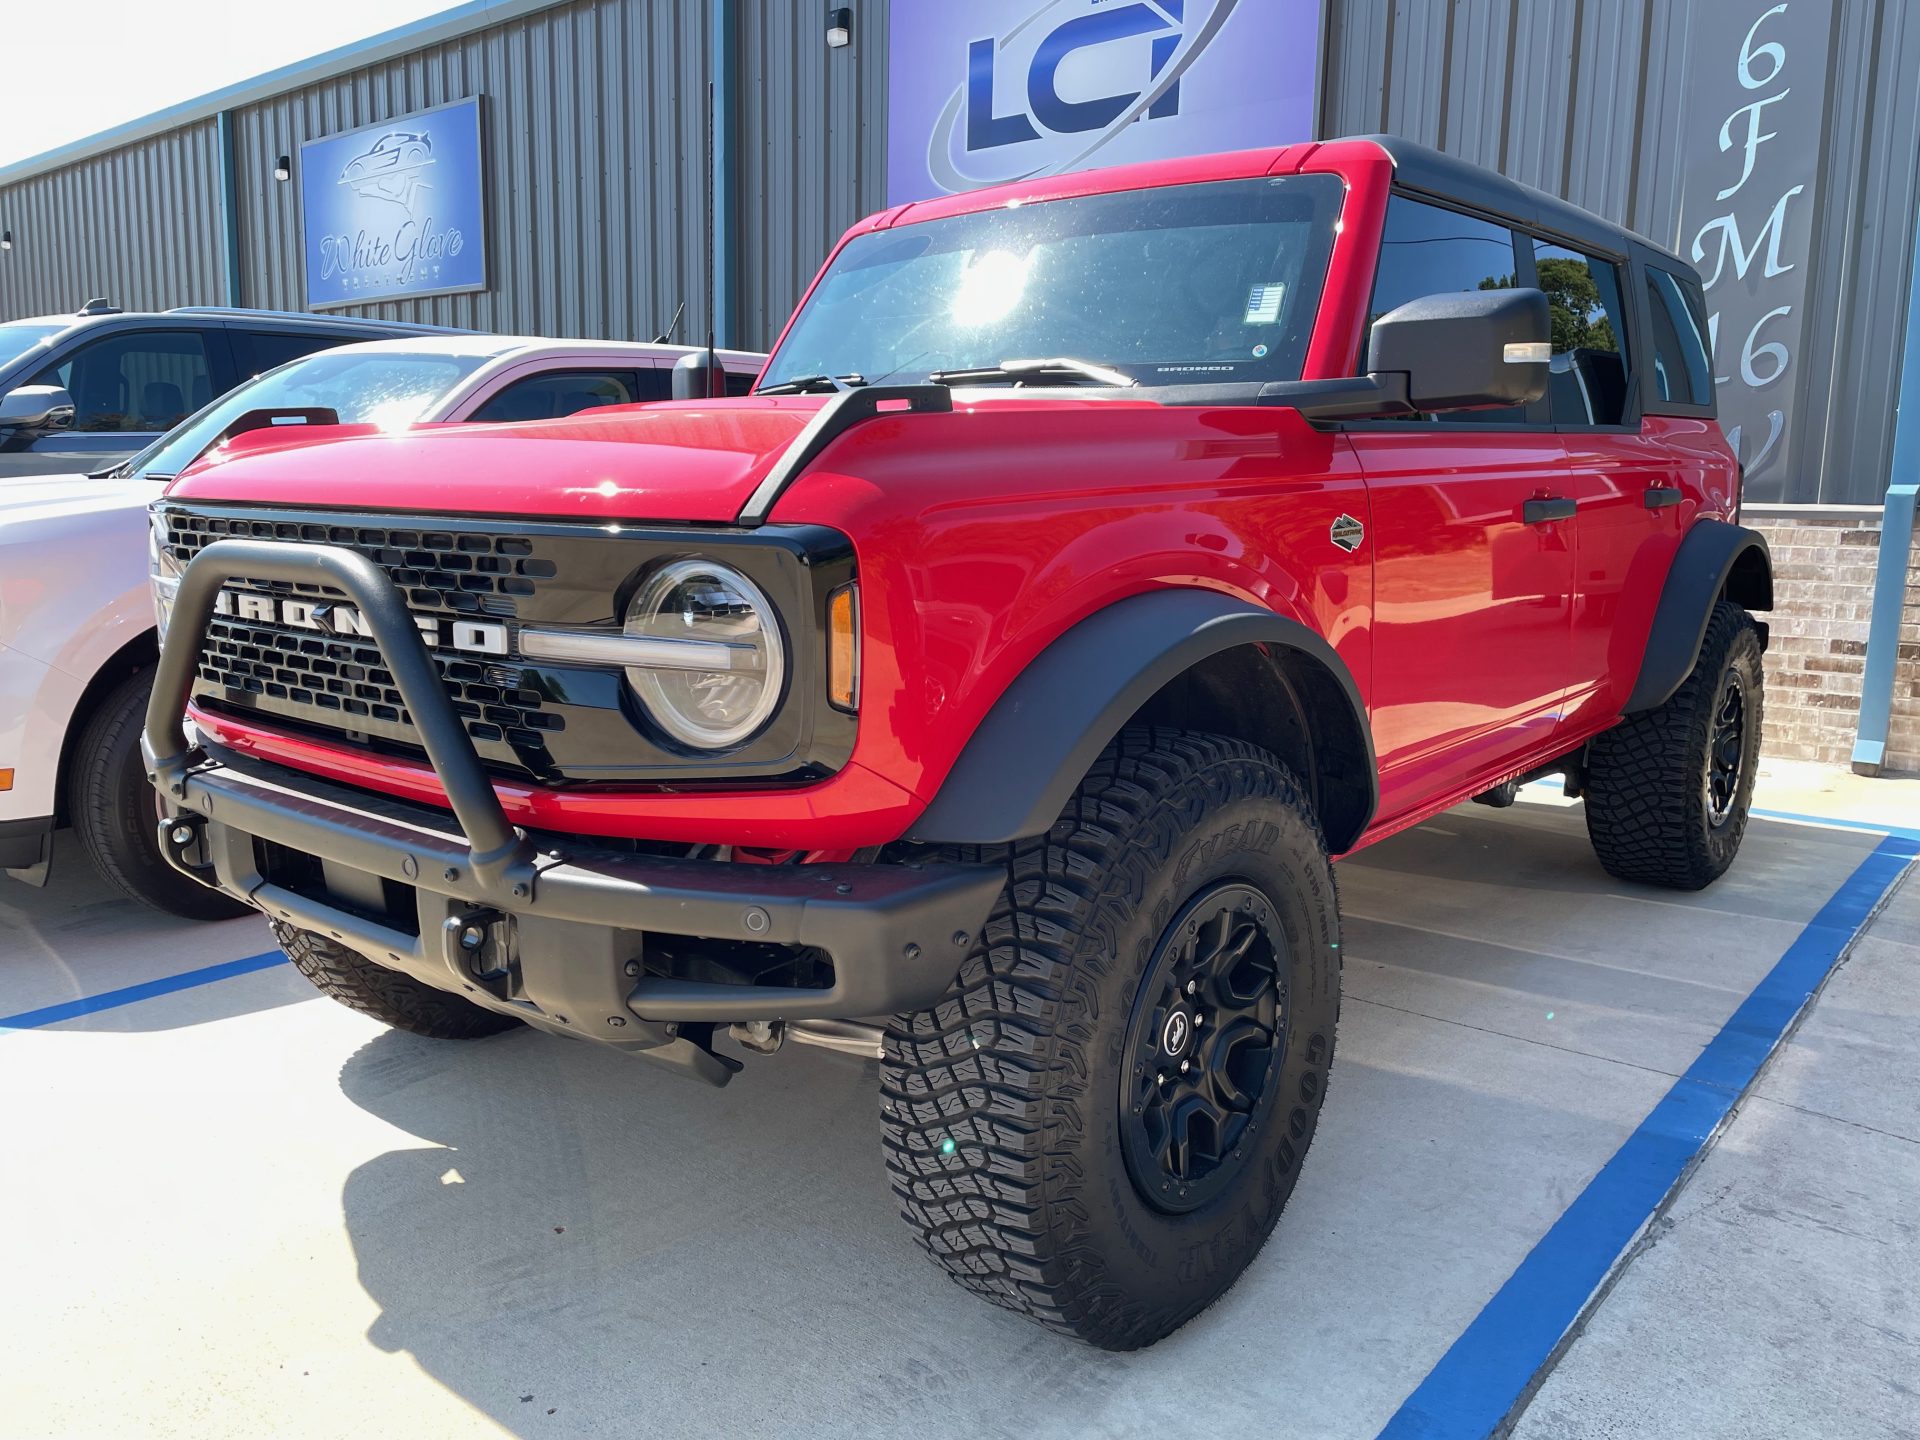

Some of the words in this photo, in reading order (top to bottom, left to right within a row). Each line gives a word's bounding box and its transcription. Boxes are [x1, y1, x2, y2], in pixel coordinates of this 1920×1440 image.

[320, 229, 390, 280] White
[395, 217, 464, 285] Glove
[342, 265, 440, 291] TREATMENT
